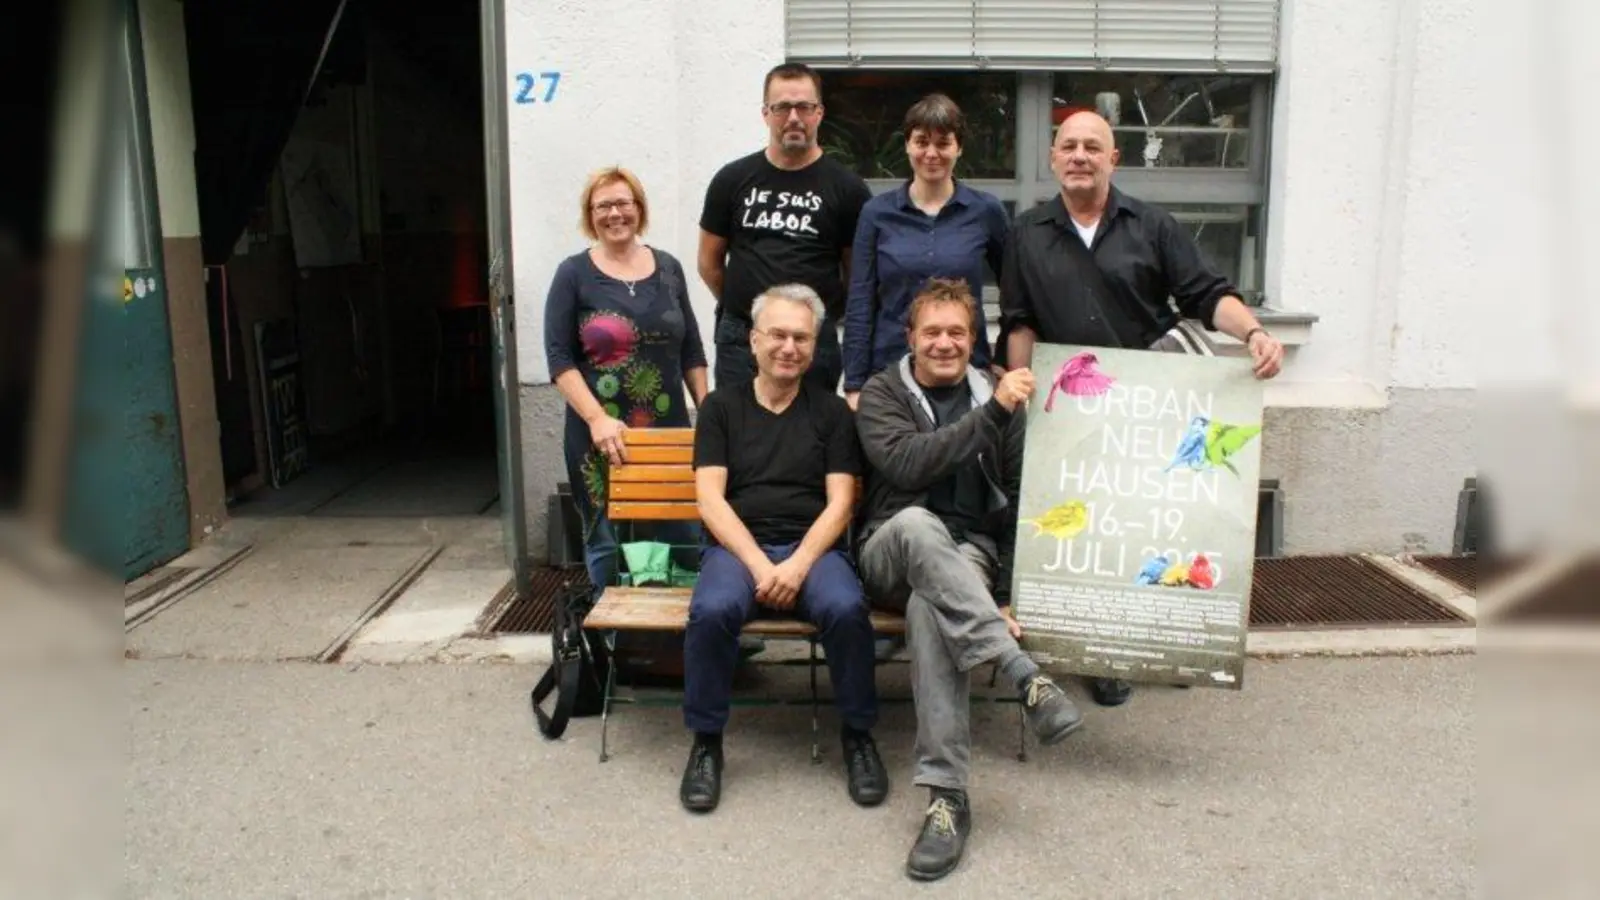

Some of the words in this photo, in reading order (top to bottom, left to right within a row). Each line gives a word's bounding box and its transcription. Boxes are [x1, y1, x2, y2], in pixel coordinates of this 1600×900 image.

[515, 71, 561, 104] 27
[744, 187, 772, 206] JE
[742, 209, 819, 234] LABOR
[1076, 384, 1214, 421] URBAN
[1059, 458, 1219, 505] HAUSEN
[1042, 538, 1125, 577] JULI
